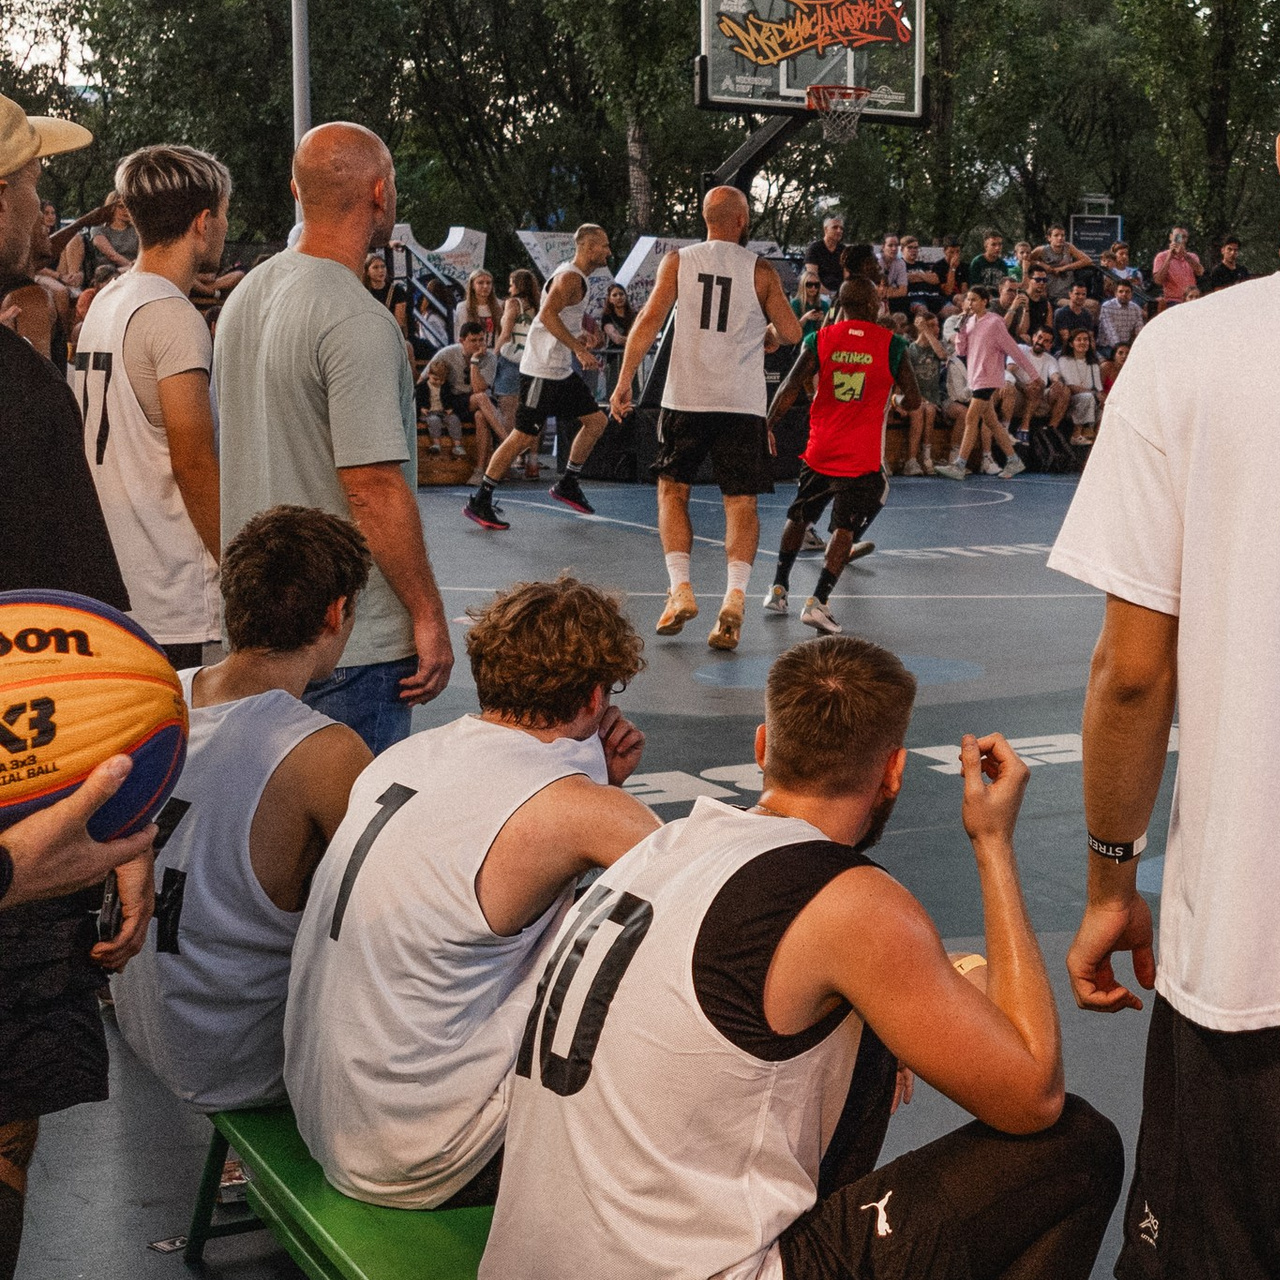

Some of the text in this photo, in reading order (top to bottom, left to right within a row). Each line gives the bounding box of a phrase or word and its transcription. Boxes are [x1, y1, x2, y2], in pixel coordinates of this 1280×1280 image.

[698, 273, 732, 332] 11
[833, 371, 866, 401] 21
[27, 762, 60, 779] BALL
[329, 782, 419, 942] 1
[515, 884, 654, 1096] 10
